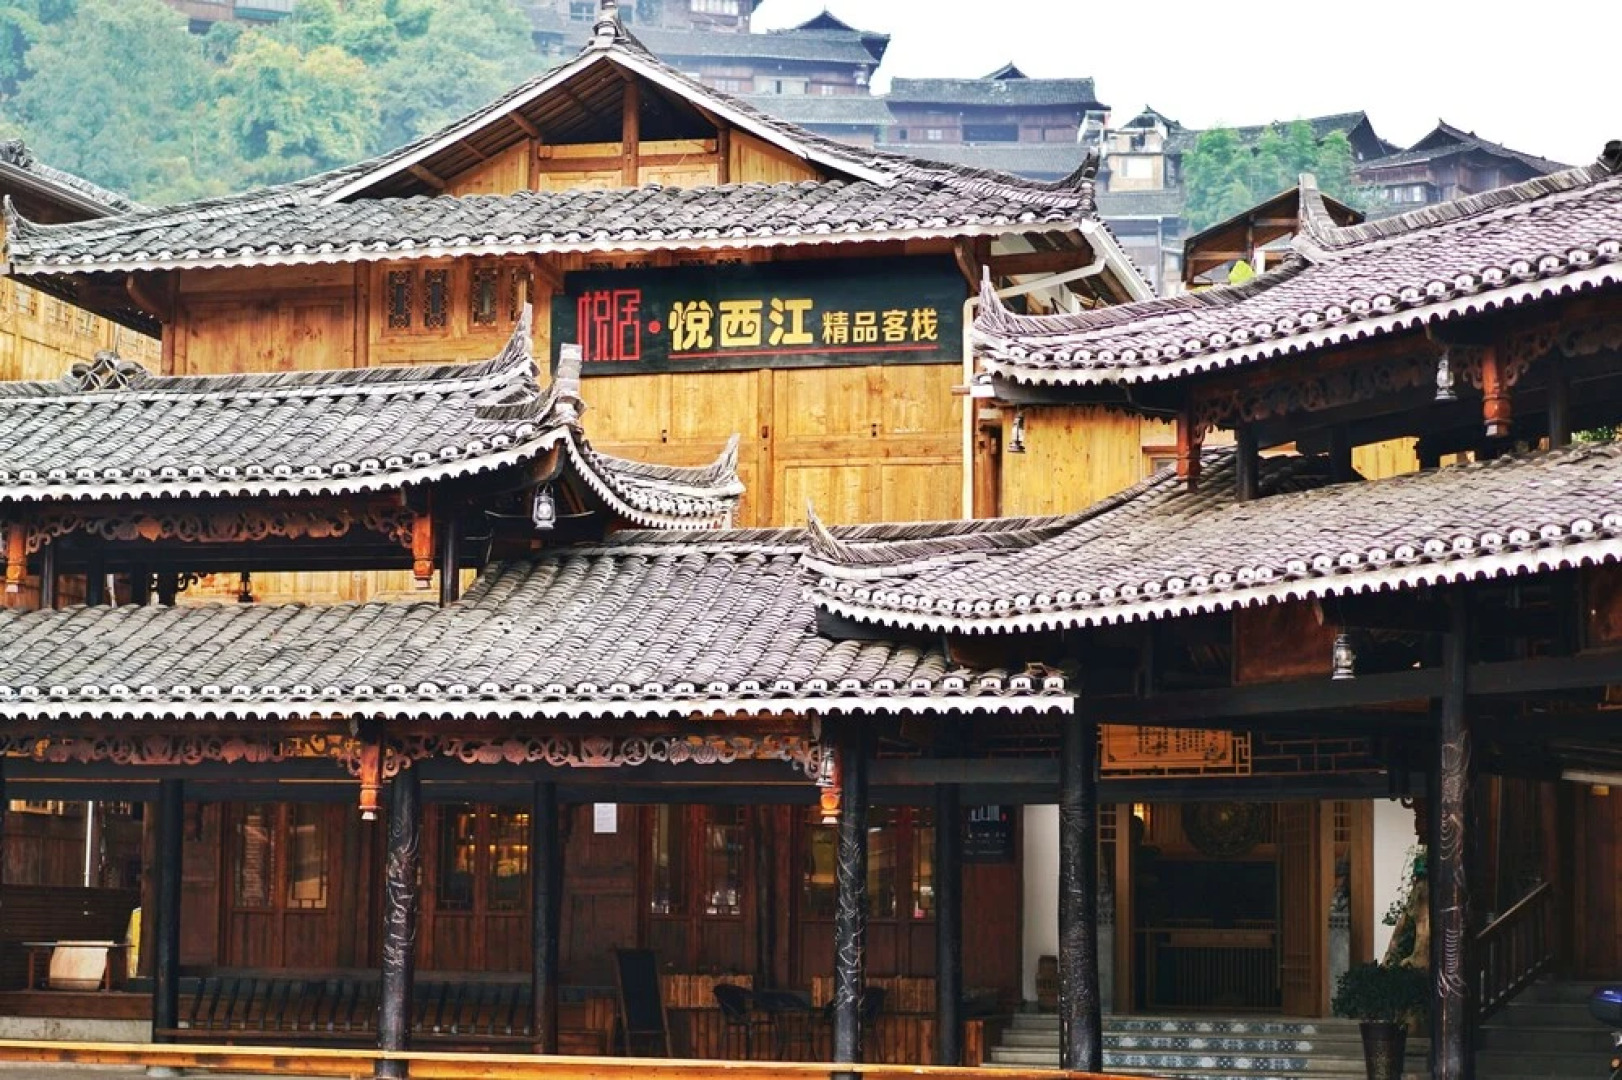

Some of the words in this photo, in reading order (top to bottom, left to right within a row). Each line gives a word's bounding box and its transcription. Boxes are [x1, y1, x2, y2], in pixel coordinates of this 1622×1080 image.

[668, 297, 814, 351] 悦西江
[822, 308, 938, 345] 精品客栈
